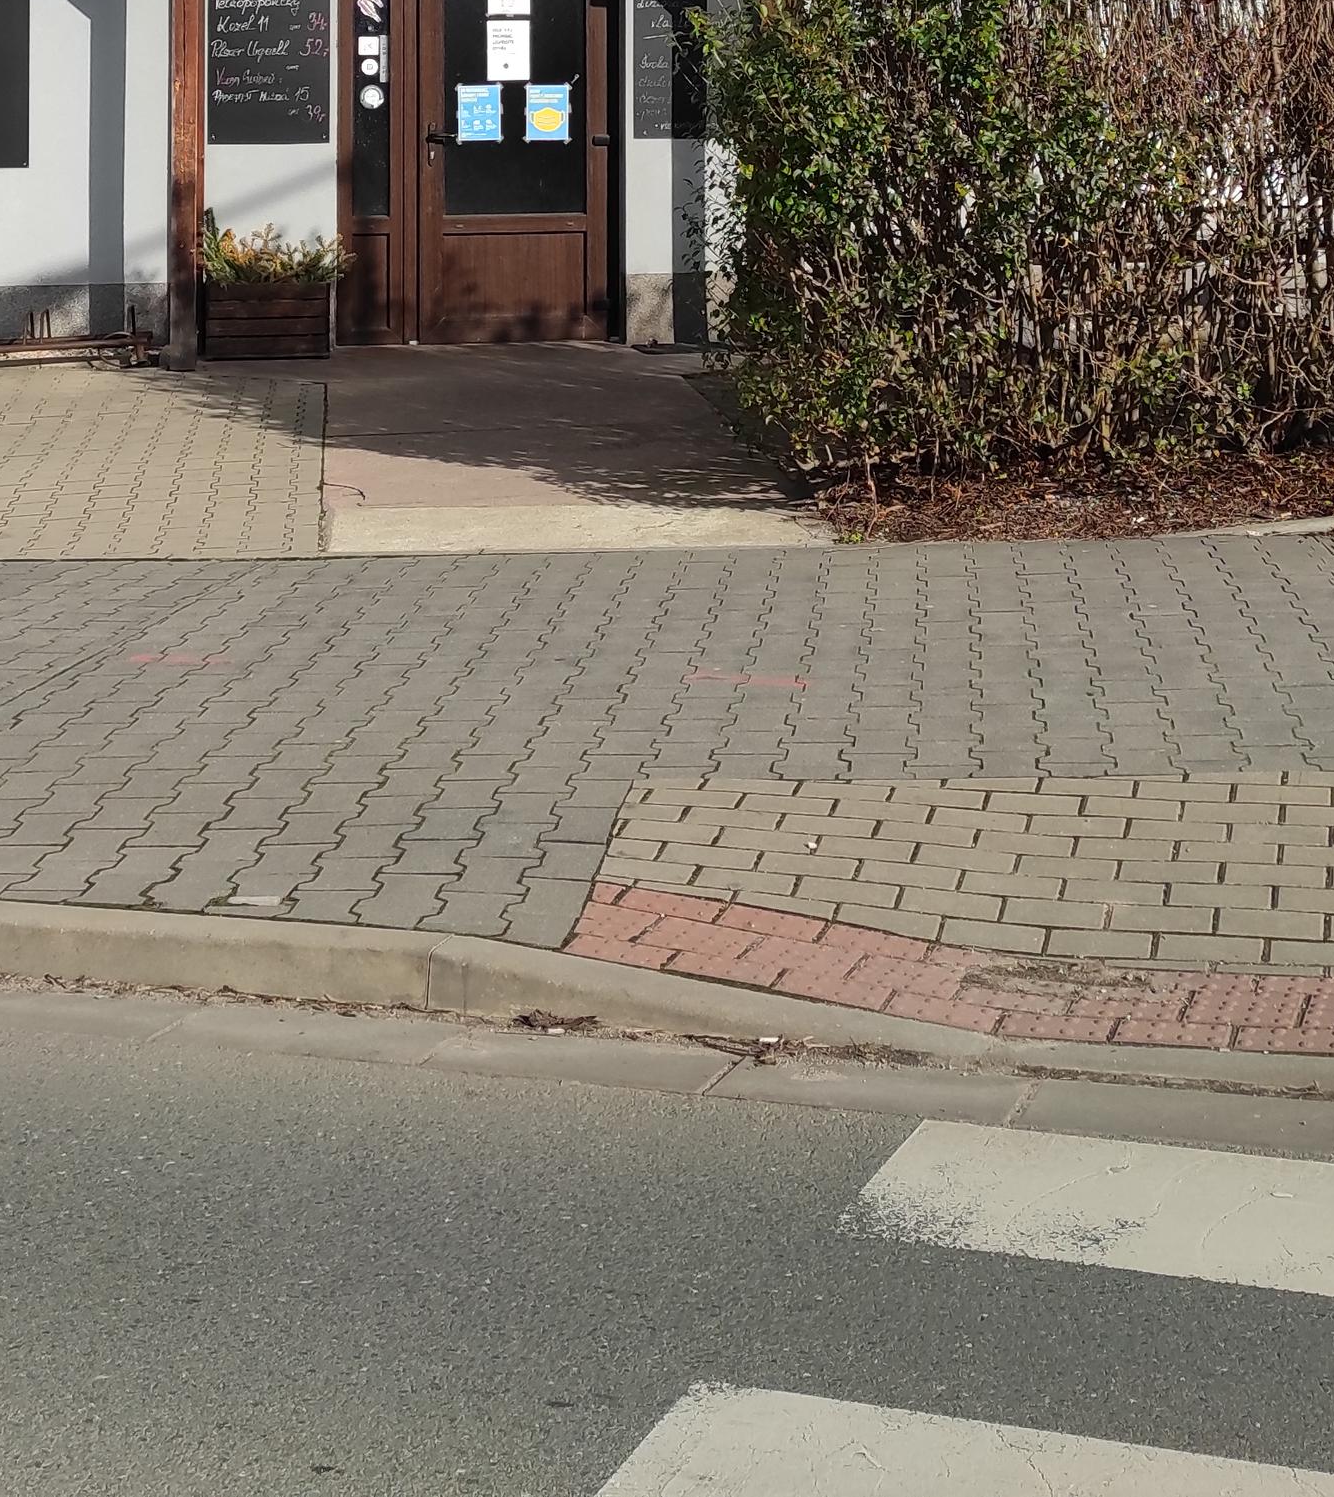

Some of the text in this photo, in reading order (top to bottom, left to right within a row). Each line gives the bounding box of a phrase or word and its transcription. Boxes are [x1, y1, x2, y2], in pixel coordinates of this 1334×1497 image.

[216, 14, 256, 34] Kozel
[257, 15, 270, 33] 11
[294, 86, 311, 102] 15
